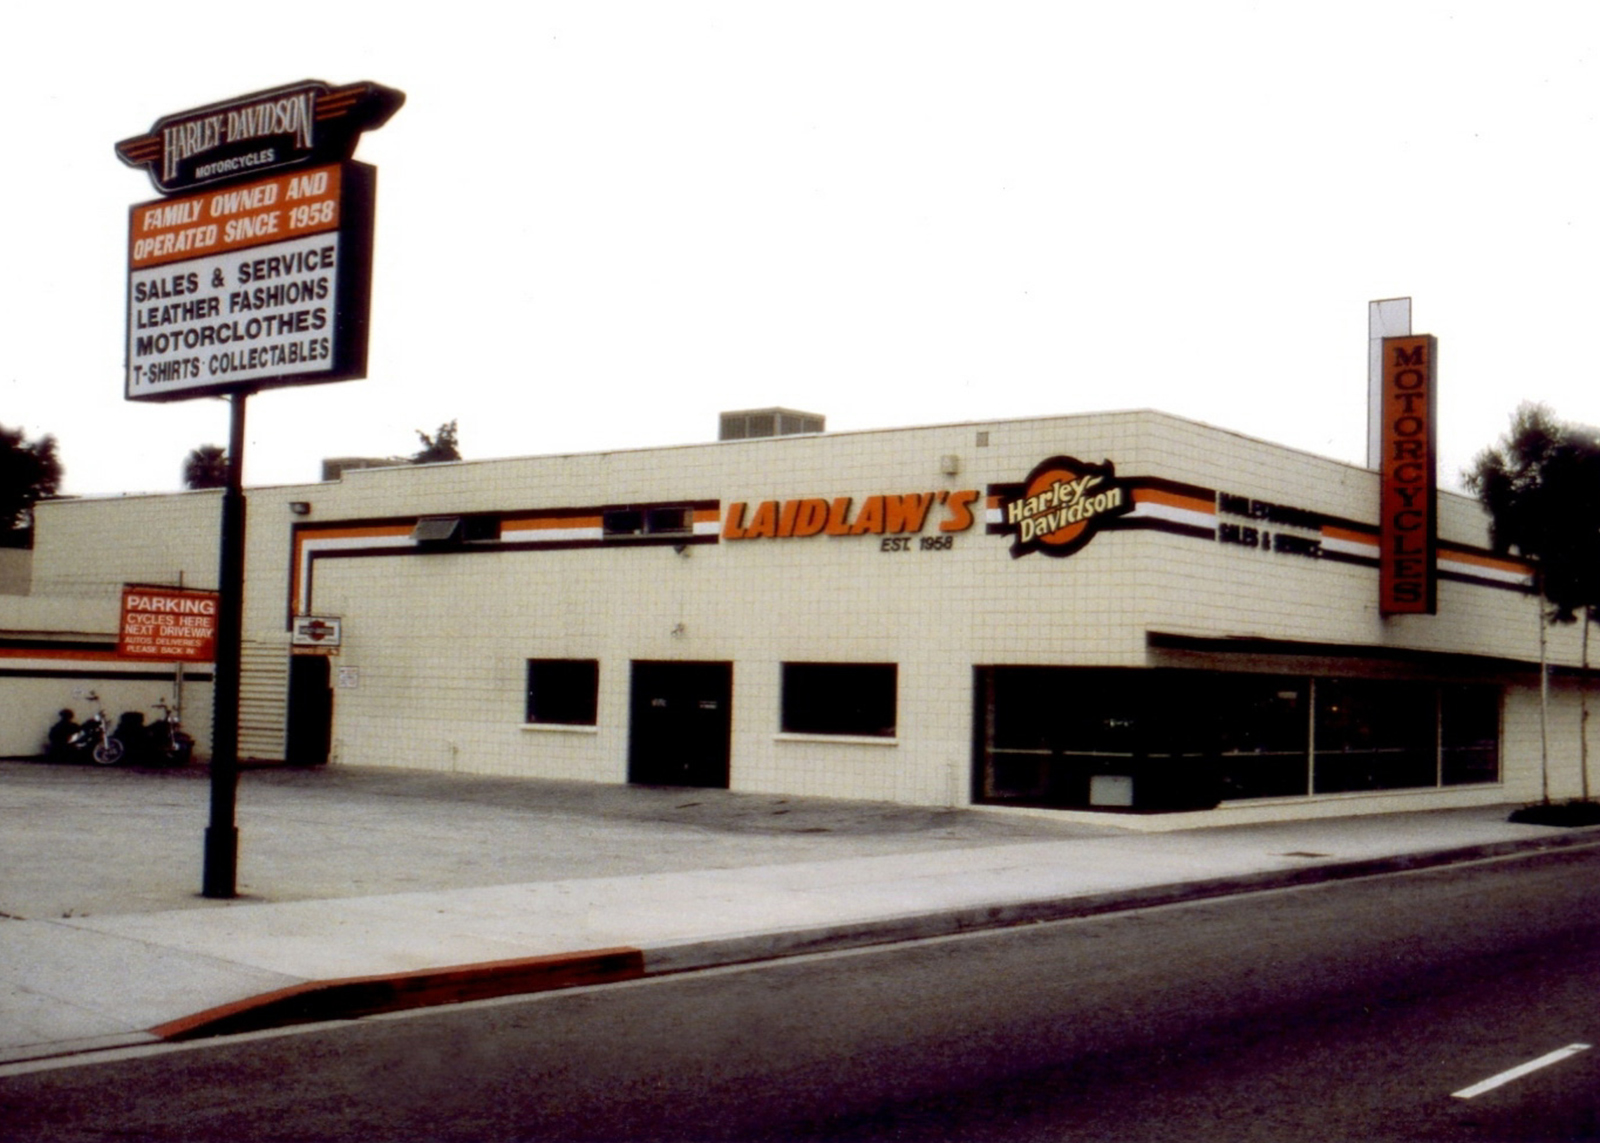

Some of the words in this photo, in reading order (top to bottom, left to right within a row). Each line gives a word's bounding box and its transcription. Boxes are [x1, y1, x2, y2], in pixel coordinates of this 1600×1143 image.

[162, 91, 315, 182] HARLEY-DAVIDSON
[195, 149, 275, 179] MOTORCYCLES
[143, 199, 203, 231] FAMILY
[210, 183, 277, 217] OWNED
[285, 171, 328, 203] AND
[133, 226, 218, 261] OPERATED
[224, 211, 281, 243] SINCE
[289, 201, 335, 230] 1958
[134, 272, 199, 304] SALES
[211, 267, 225, 288] &
[238, 246, 335, 285] SERVICE
[137, 297, 220, 330] LEATHER
[229, 277, 329, 315] FASHIONS
[136, 307, 327, 358] MOTORCLOTHES
[133, 357, 200, 385] T-SHIRTS
[208, 337, 330, 376] COLLECTABLES
[1393, 345, 1424, 603] MOTORCYCLES
[721, 490, 980, 540] LAIDLAW'S
[1020, 487, 1121, 543] Davidson
[919, 536, 953, 551] 1958
[127, 595, 214, 615] PARKING
[127, 613, 174, 625] CYCLES
[179, 616, 211, 627] HERE
[125, 624, 154, 635] NEXT
[160, 626, 213, 638] DRIVEWAY
[126, 645, 157, 653] PLEASE
[161, 646, 182, 655] BACK
